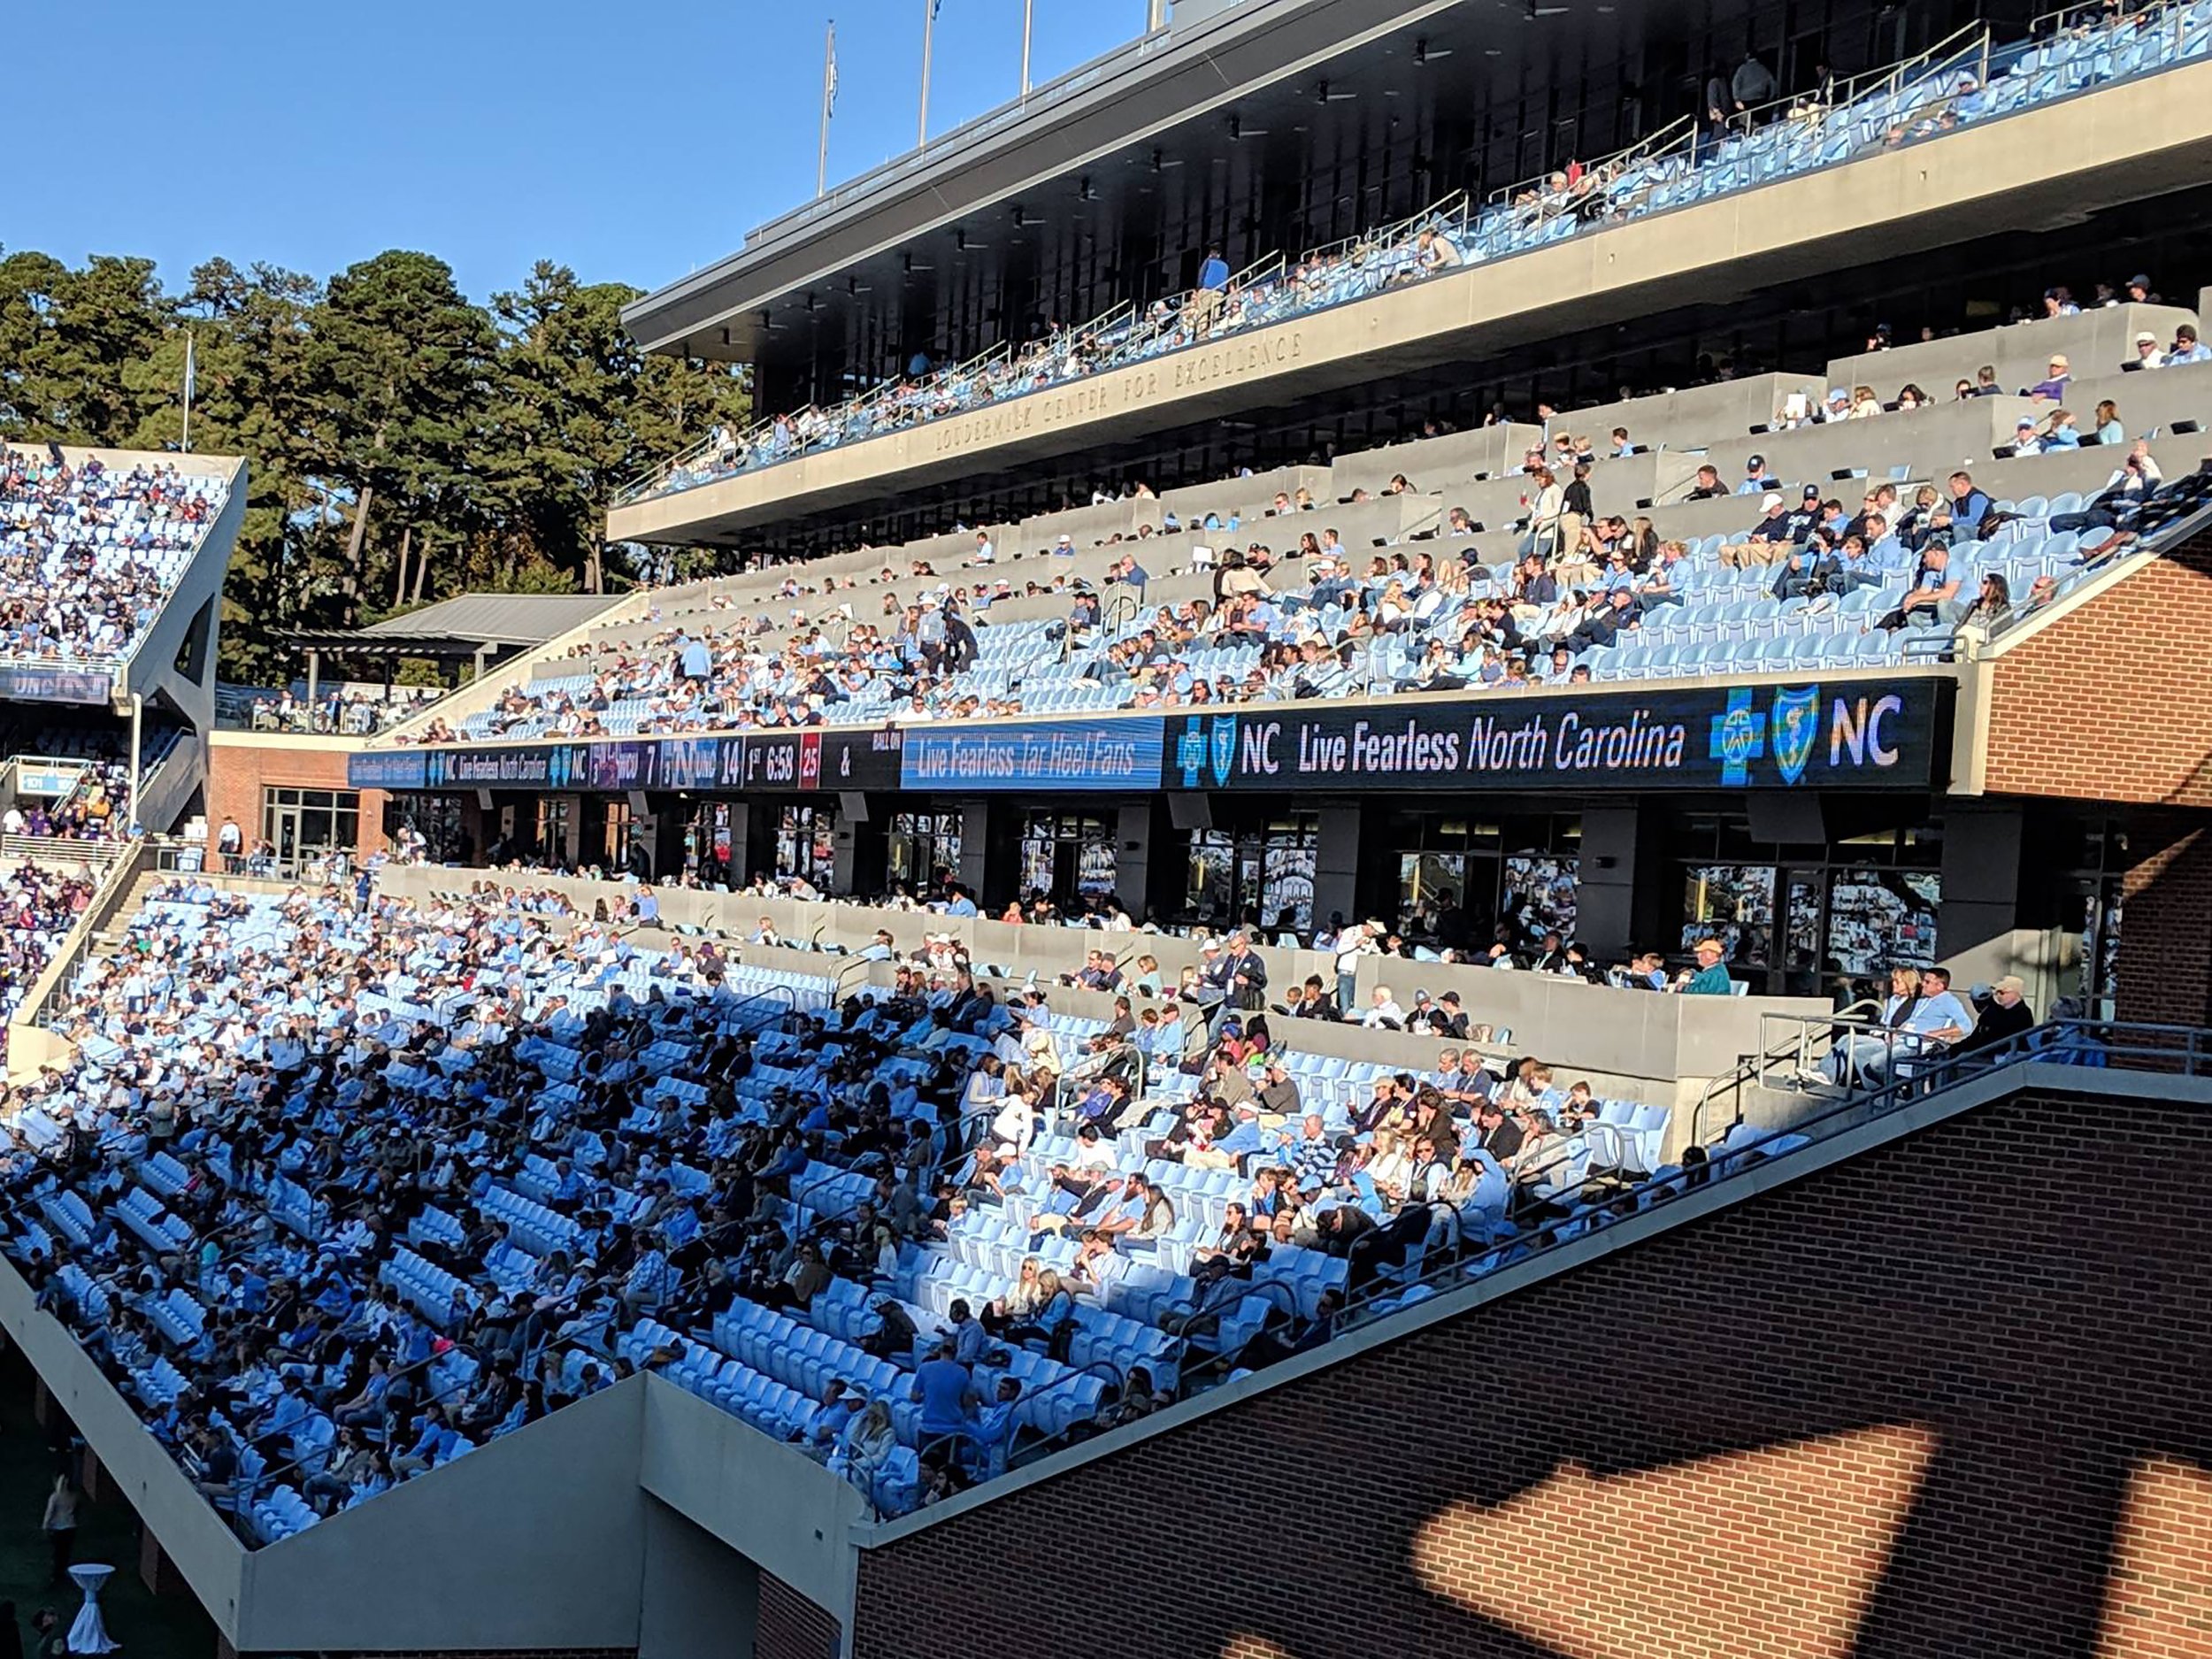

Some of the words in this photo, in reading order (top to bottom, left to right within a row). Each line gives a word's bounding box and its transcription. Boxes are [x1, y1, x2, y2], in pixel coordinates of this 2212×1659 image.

[935, 405, 1032, 451] LOUDERMILK
[1044, 387, 1107, 422] CENTER
[1124, 373, 1156, 401] FOR
[1175, 333, 1302, 387] EXCELLENCE
[1241, 722, 1281, 775] NC
[1299, 724, 1346, 772] Live
[1353, 719, 1459, 772] Fearless
[1467, 714, 1547, 770] North
[1555, 710, 1686, 770] Carolina
[1830, 695, 1901, 766] NC
[572, 749, 587, 780] NC
[647, 745, 656, 784] 7
[695, 749, 717, 778] UNC
[721, 741, 739, 785] 14
[766, 746, 794, 781] 6:58
[803, 748, 818, 777] 25
[841, 746, 850, 777] &
[918, 740, 947, 777] Live
[950, 736, 1015, 777] Fearless
[1021, 733, 1047, 776] Tar
[1049, 732, 1091, 775] Heel
[1091, 730, 1135, 775] Fans
